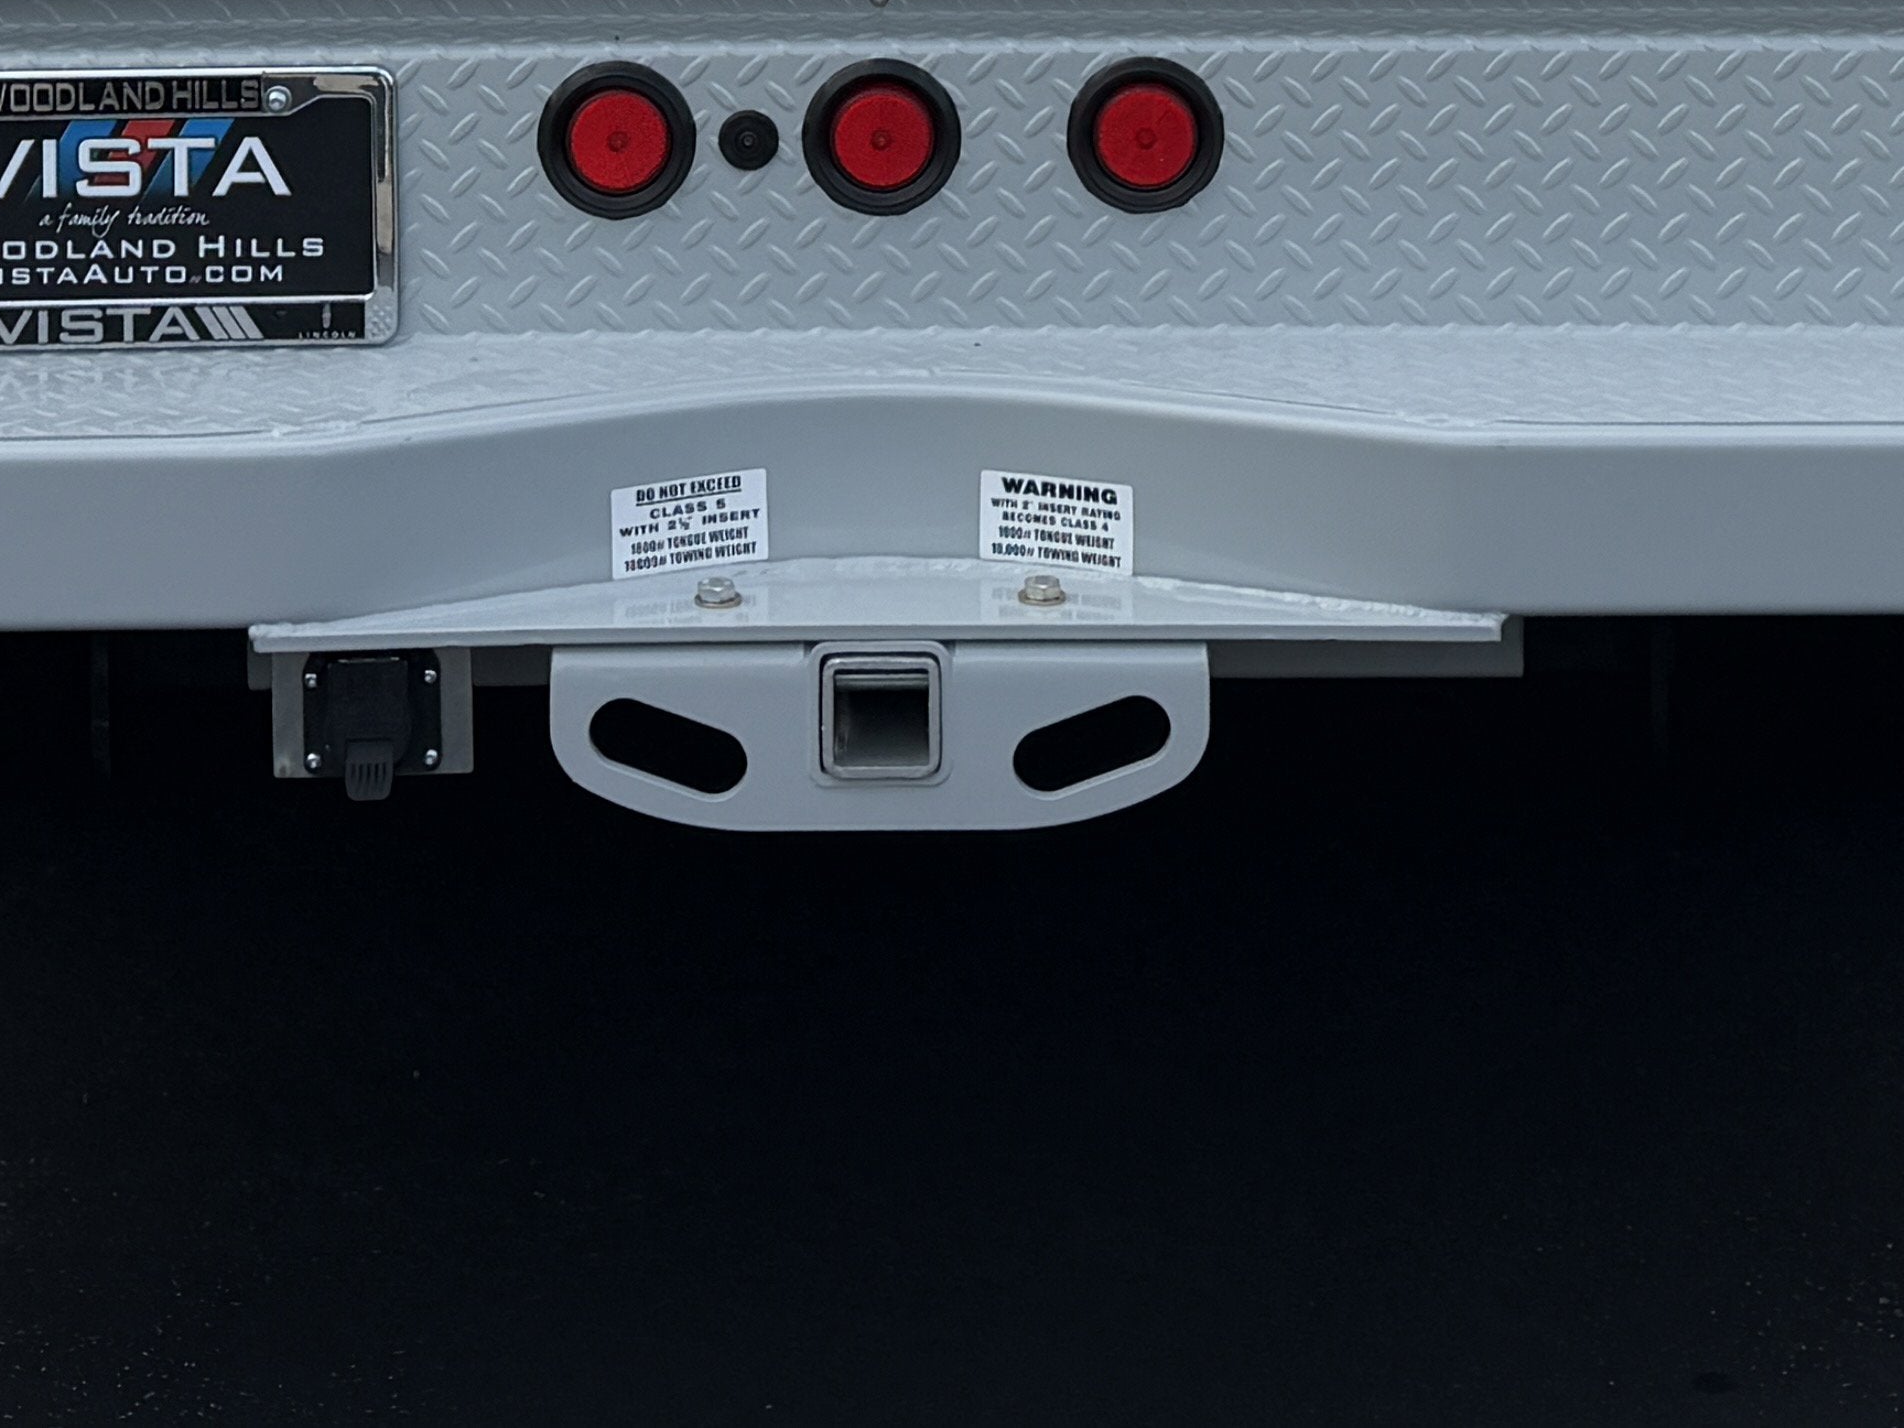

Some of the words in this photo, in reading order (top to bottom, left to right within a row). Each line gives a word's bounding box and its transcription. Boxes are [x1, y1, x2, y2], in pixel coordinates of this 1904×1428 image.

[171, 79, 261, 110] HILLS
[39, 213, 53, 227] a
[55, 202, 120, 238] family
[127, 205, 210, 227] tradition
[298, 330, 356, 339] LINCOLN
[636, 488, 655, 503] DO
[659, 482, 687, 498] NOT
[691, 475, 742, 494] EXCEED
[1002, 477, 1117, 505] WARNING
[650, 501, 708, 519] CLASS
[991, 498, 1018, 508] WITH
[1038, 502, 1077, 515] INSERT
[1081, 507, 1121, 520] RATING
[1002, 511, 1056, 526] BECOMES
[1061, 518, 1097, 530] CLASS
[619, 522, 659, 537] WITH
[702, 508, 761, 525] INSERT
[668, 532, 706, 549] TONGUE
[709, 526, 749, 543] WEIGHT
[1034, 529, 1073, 544] TONGUE
[1074, 534, 1114, 550] WEIGHT
[670, 547, 712, 565] TOWING
[715, 541, 757, 558] WEIGHT
[1037, 547, 1079, 562] TOWING
[1081, 552, 1121, 568] WEIGHT
